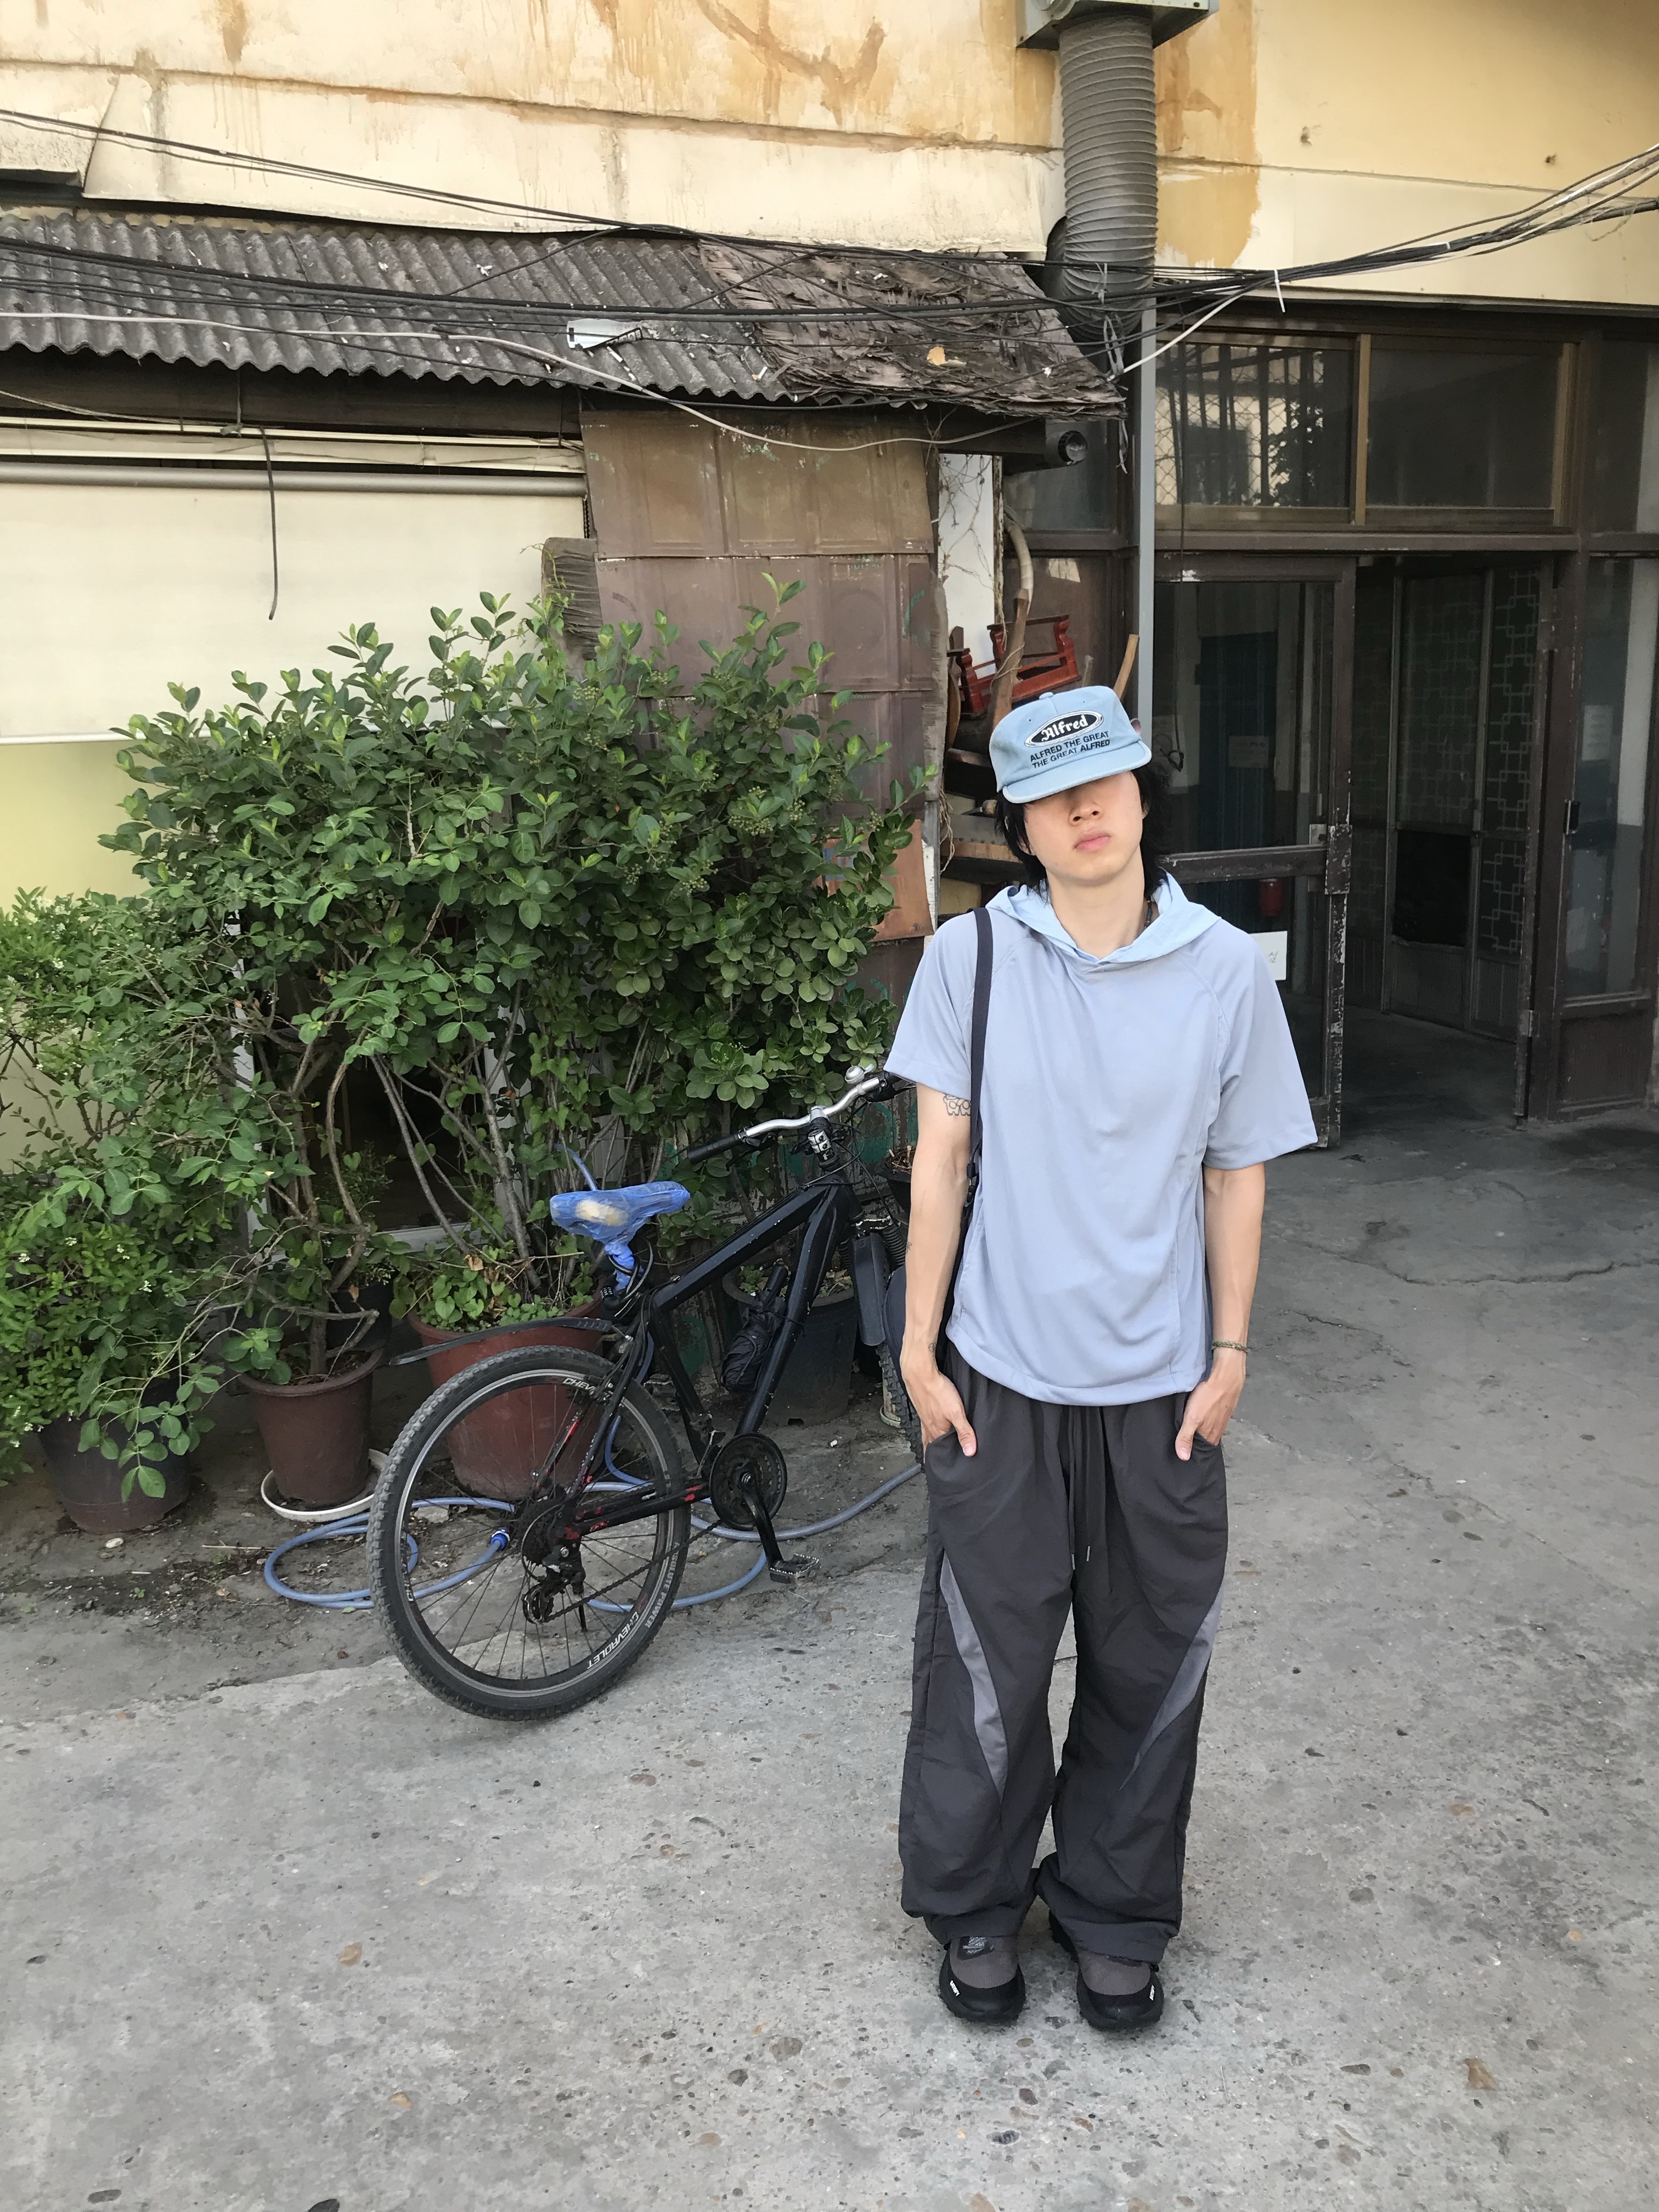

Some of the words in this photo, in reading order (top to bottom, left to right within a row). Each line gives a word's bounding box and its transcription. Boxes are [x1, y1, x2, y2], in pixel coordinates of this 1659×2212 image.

[1041, 714, 1088, 742] Alfred
[1030, 744, 1062, 763] ALFRED
[1063, 738, 1081, 748] THE
[1083, 731, 1109, 743] GREAT
[1032, 758, 1048, 769] THE
[1050, 747, 1077, 761] GREAT
[1080, 739, 1110, 752] ALFRED
[644, 1592, 667, 1628] POWER
[587, 1611, 639, 1669] CHEVROLET
